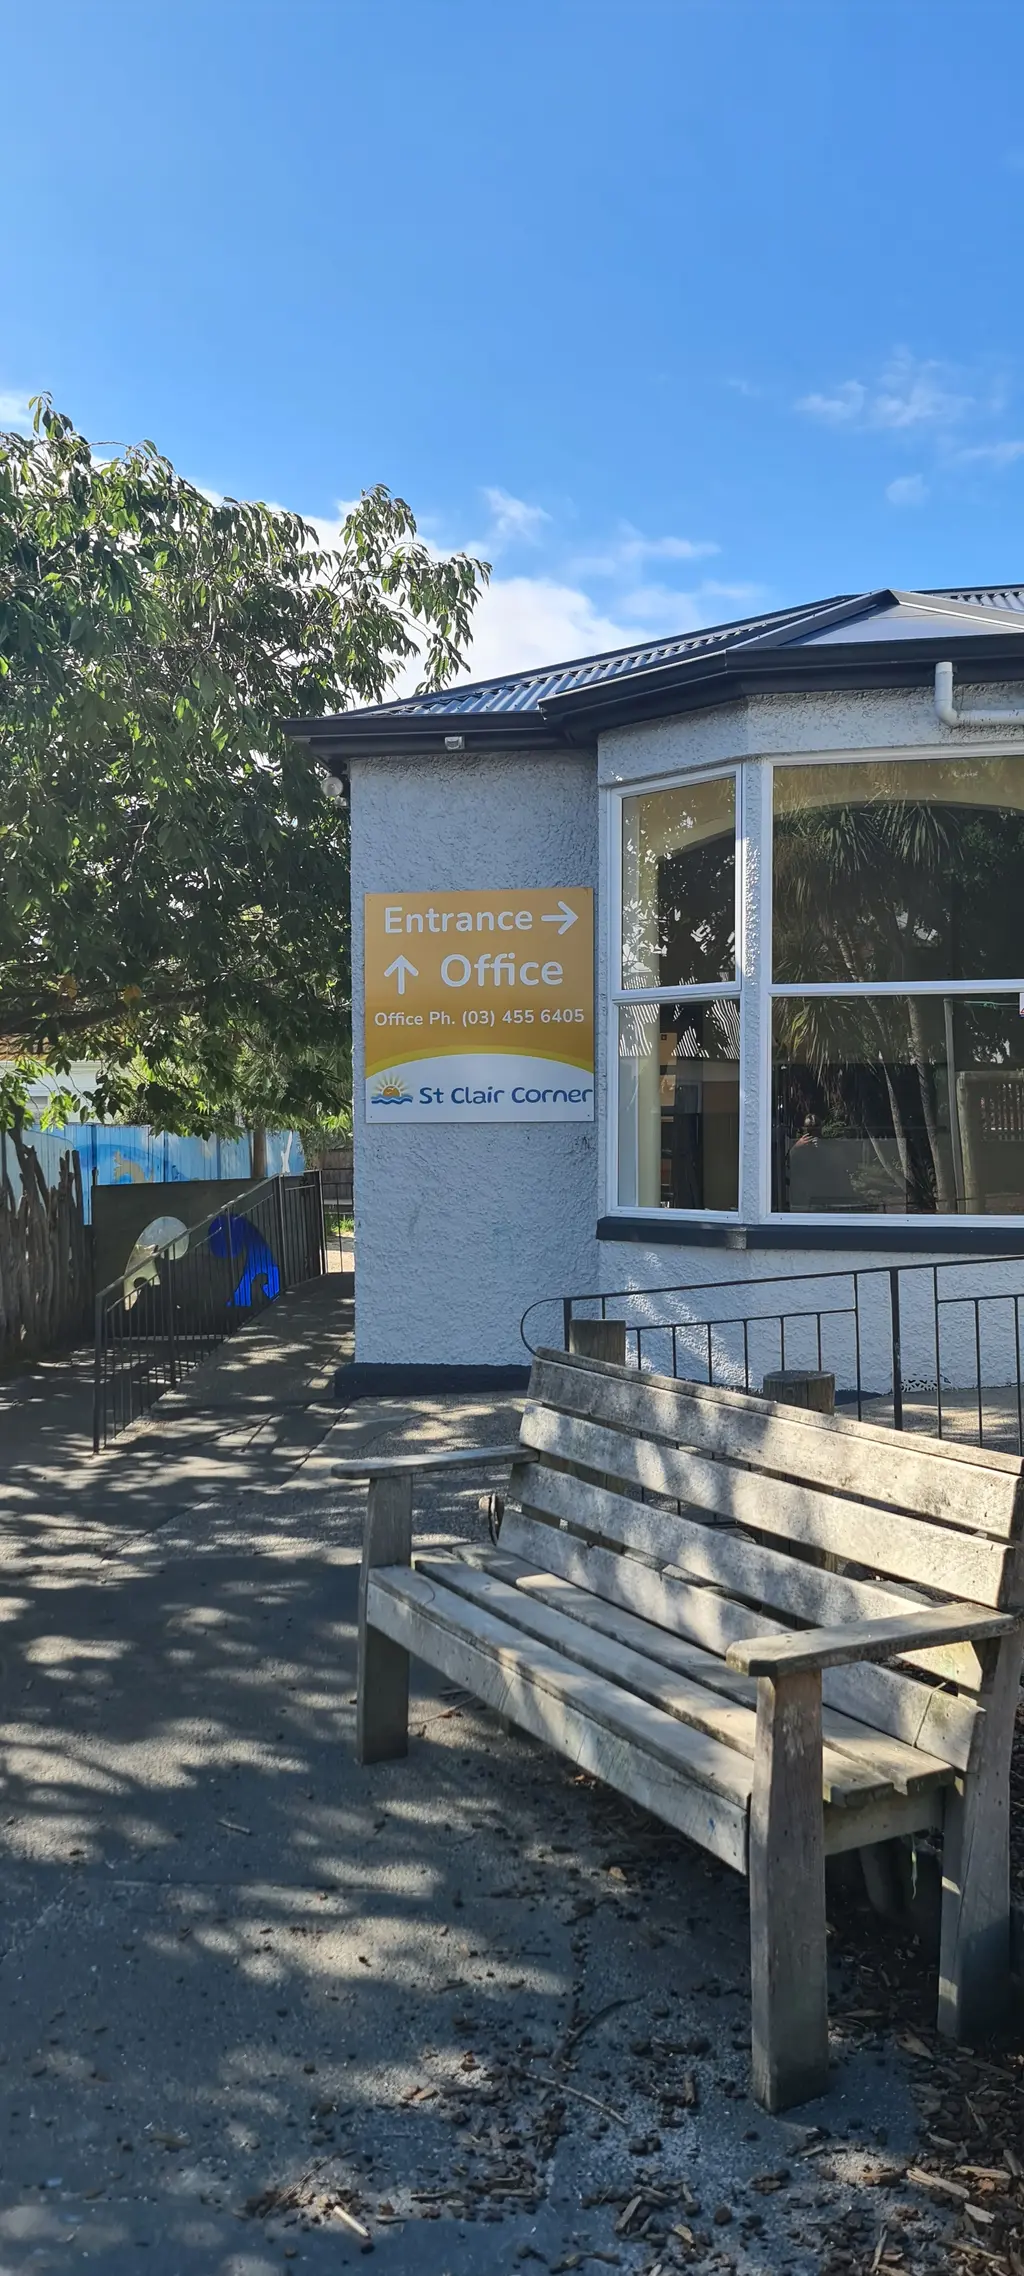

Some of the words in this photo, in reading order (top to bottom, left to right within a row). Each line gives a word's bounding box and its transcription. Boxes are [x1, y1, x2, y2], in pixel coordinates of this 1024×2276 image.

[384, 905, 533, 934] Entrance
[440, 952, 564, 988] Office
[374, 1011, 424, 1026] Office
[429, 1010, 456, 1026] Ph.
[462, 1010, 496, 1028] (03)
[502, 1009, 535, 1024] 455
[540, 1008, 585, 1023] 6405
[419, 1087, 445, 1105] St
[450, 1086, 505, 1105] Clair
[511, 1087, 594, 1103] Corner
